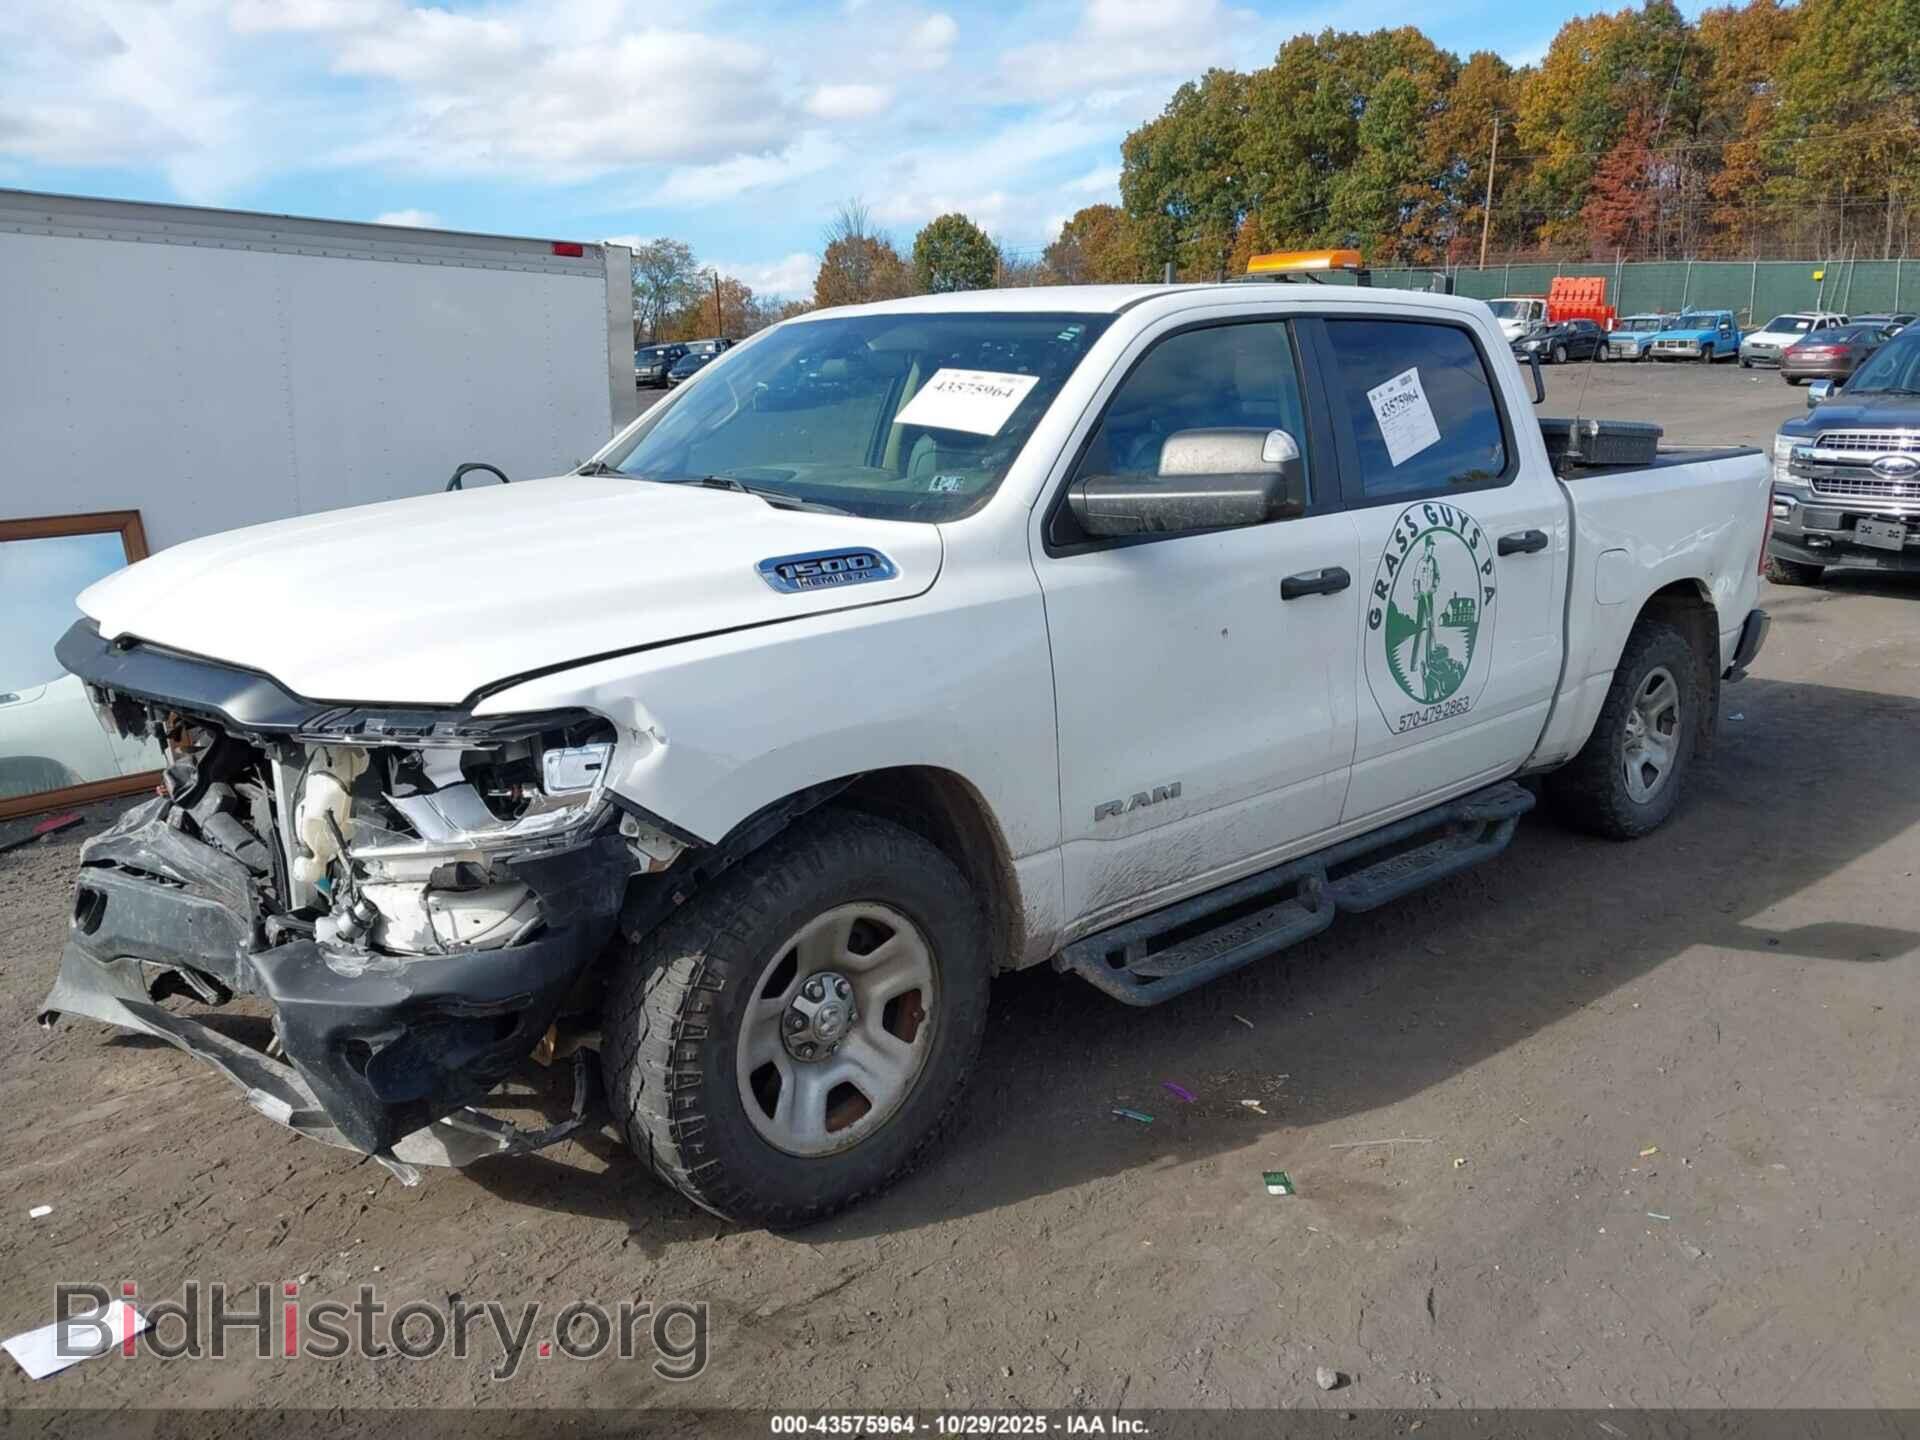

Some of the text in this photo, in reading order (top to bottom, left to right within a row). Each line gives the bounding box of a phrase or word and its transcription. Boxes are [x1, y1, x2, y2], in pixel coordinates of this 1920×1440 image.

[933, 380, 1015, 399] 43575964
[1380, 386, 1420, 418] 43575964
[780, 554, 873, 579] 1500
[1368, 514, 1419, 631] GRASS
[1423, 504, 1481, 552] GUYS
[1398, 696, 1470, 732] 570-479-2863
[1094, 781, 1182, 822] RAM
